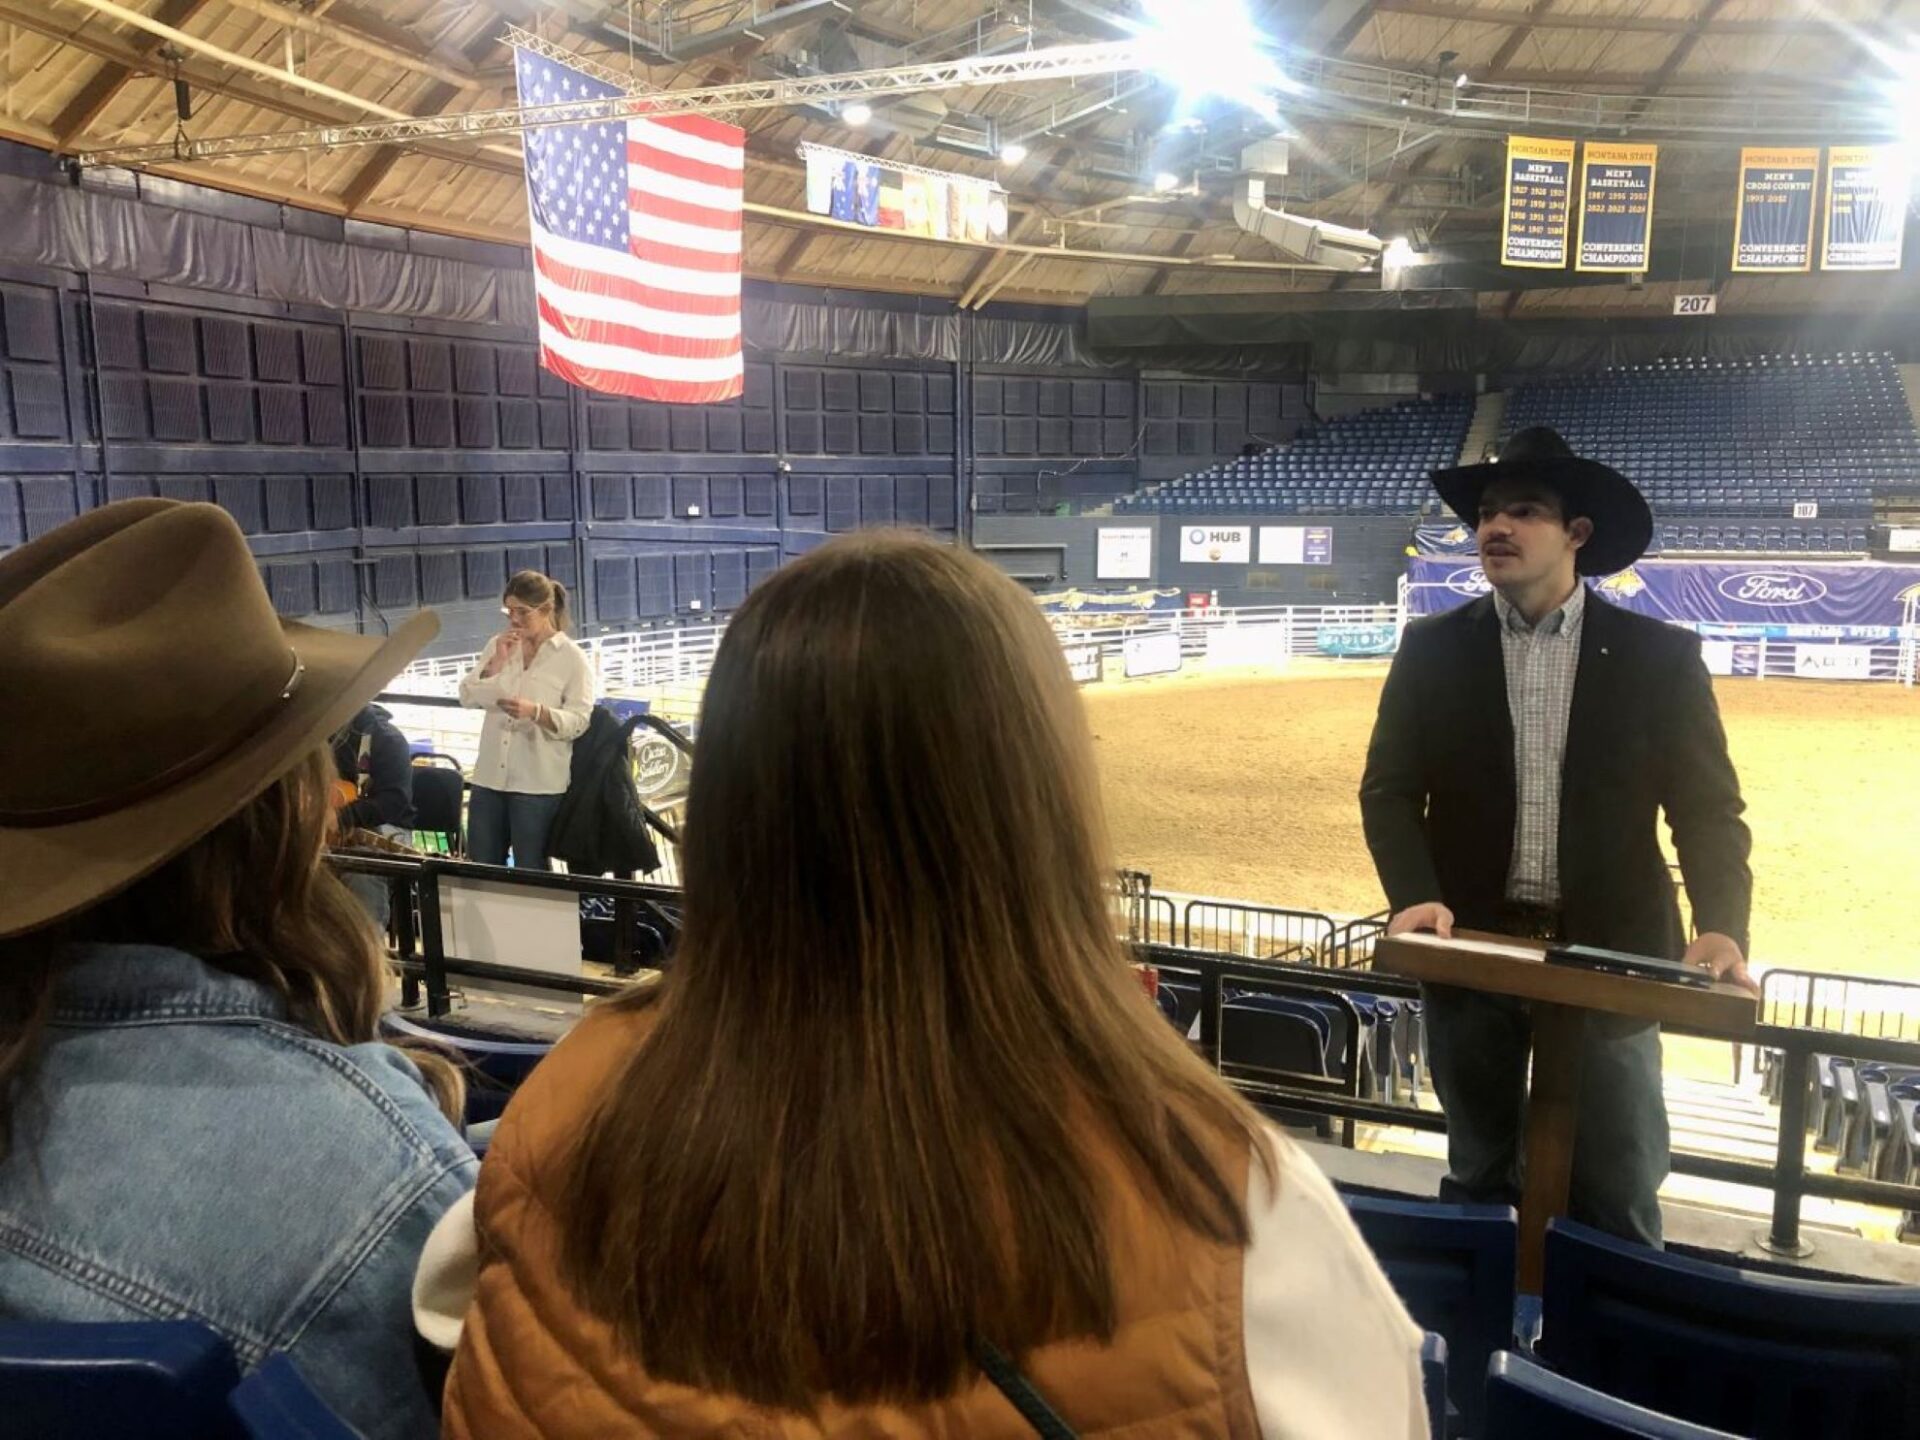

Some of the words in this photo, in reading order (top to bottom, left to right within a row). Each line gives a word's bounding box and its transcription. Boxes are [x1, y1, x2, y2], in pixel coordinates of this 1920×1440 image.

[1512, 145, 1548, 156] MONTANA
[1550, 148, 1572, 156] STATE
[1587, 151, 1628, 161] MONTANA
[1630, 152, 1653, 161] STATE
[1745, 155, 1788, 164] MONTANA
[1791, 156, 1817, 165] STATE
[1528, 164, 1553, 174] MEN'S
[1605, 169, 1632, 178] MEN'S
[1514, 173, 1564, 184] BASKETBALL
[1764, 173, 1794, 181] MEN'S
[1591, 178, 1645, 188] BASKETBALL
[1745, 182, 1772, 190] CROSS
[1772, 182, 1811, 190] COUNTRY
[1508, 237, 1563, 248] CONFERENCE
[1583, 243, 1644, 252] CONFERENCE
[1507, 247, 1561, 260] CHAMPIONS
[1739, 244, 1806, 253] CONFERENCE
[1581, 253, 1644, 263] CHAMPIONS
[1739, 254, 1806, 264] CHAMPIONS
[1680, 297, 1710, 312] 207
[1797, 505, 1814, 516] 107
[1209, 532, 1241, 543] HUB
[1738, 575, 1806, 600] Ford
